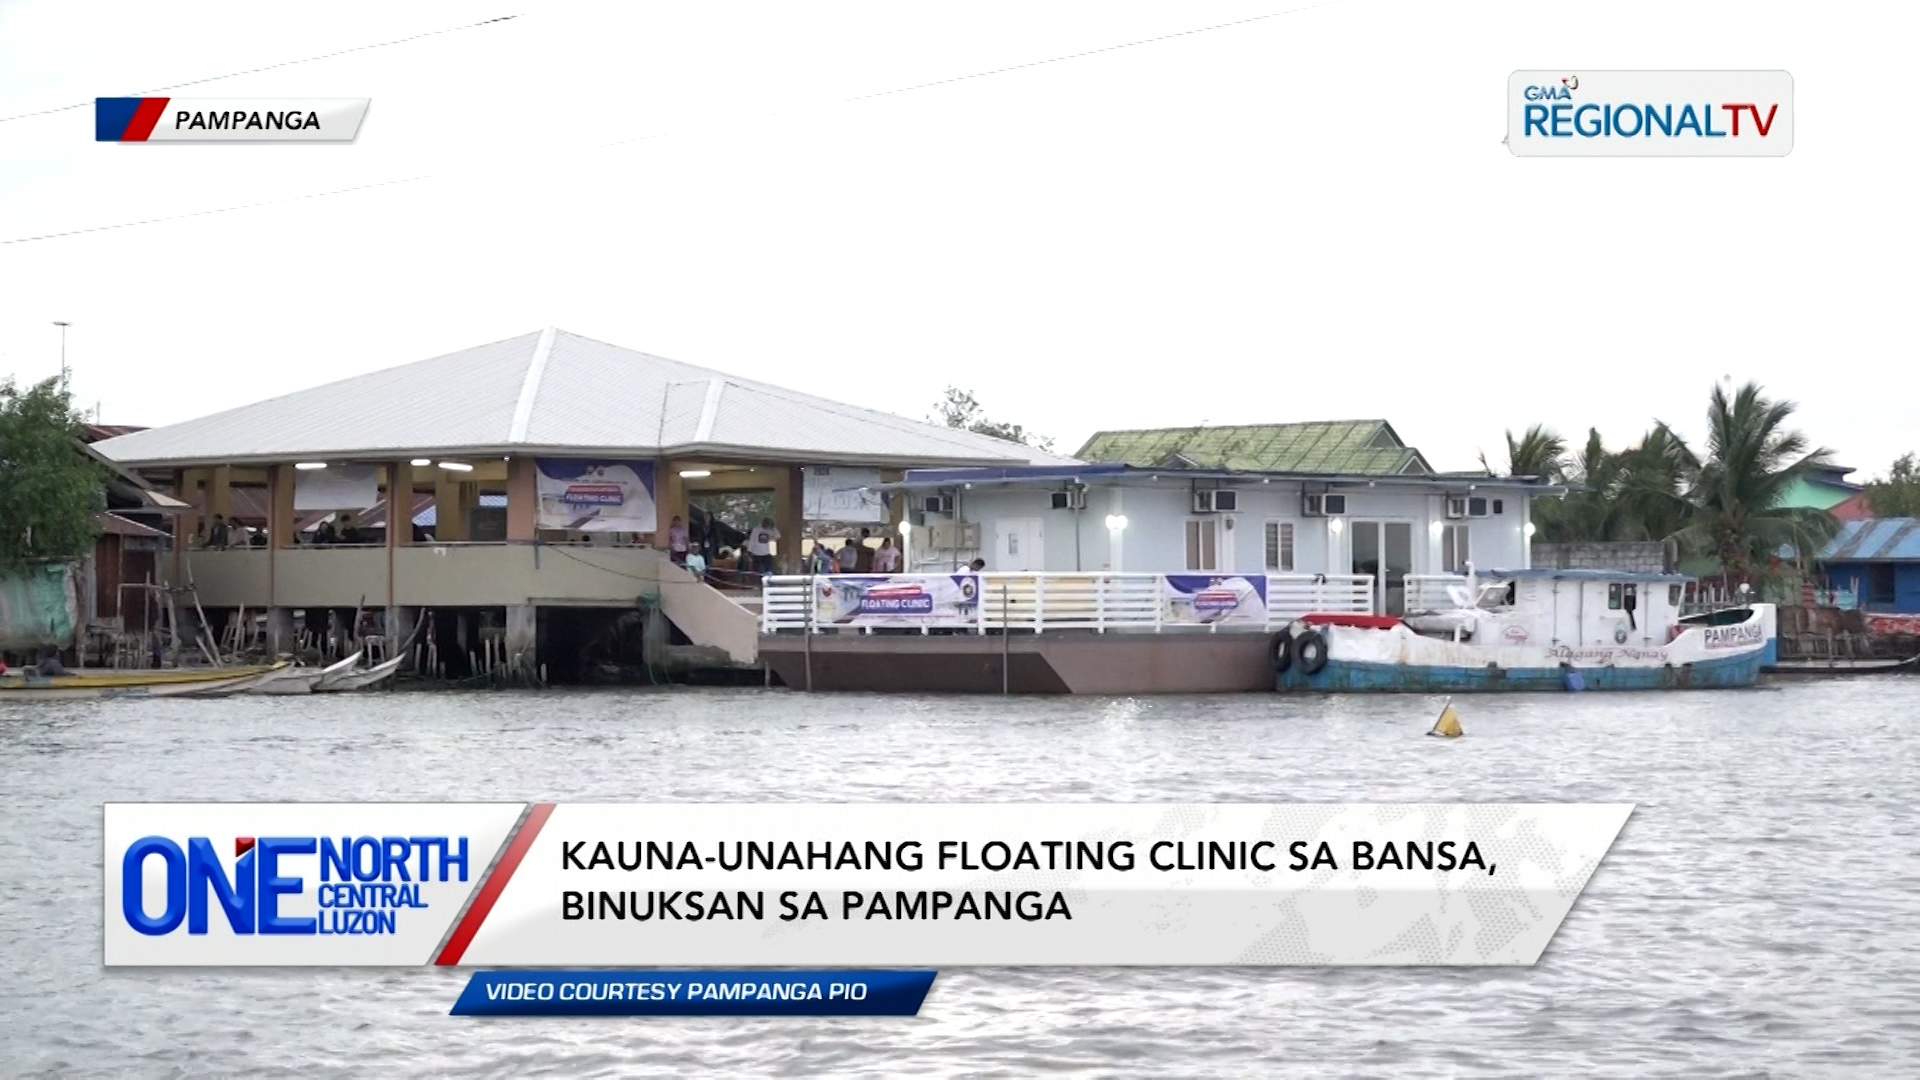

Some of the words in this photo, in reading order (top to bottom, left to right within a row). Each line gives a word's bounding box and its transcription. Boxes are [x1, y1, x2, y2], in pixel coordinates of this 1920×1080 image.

[861, 599, 900, 609] FLOATING
[901, 599, 931, 609] CLINIC
[1704, 624, 1763, 641] PAMPANGA
